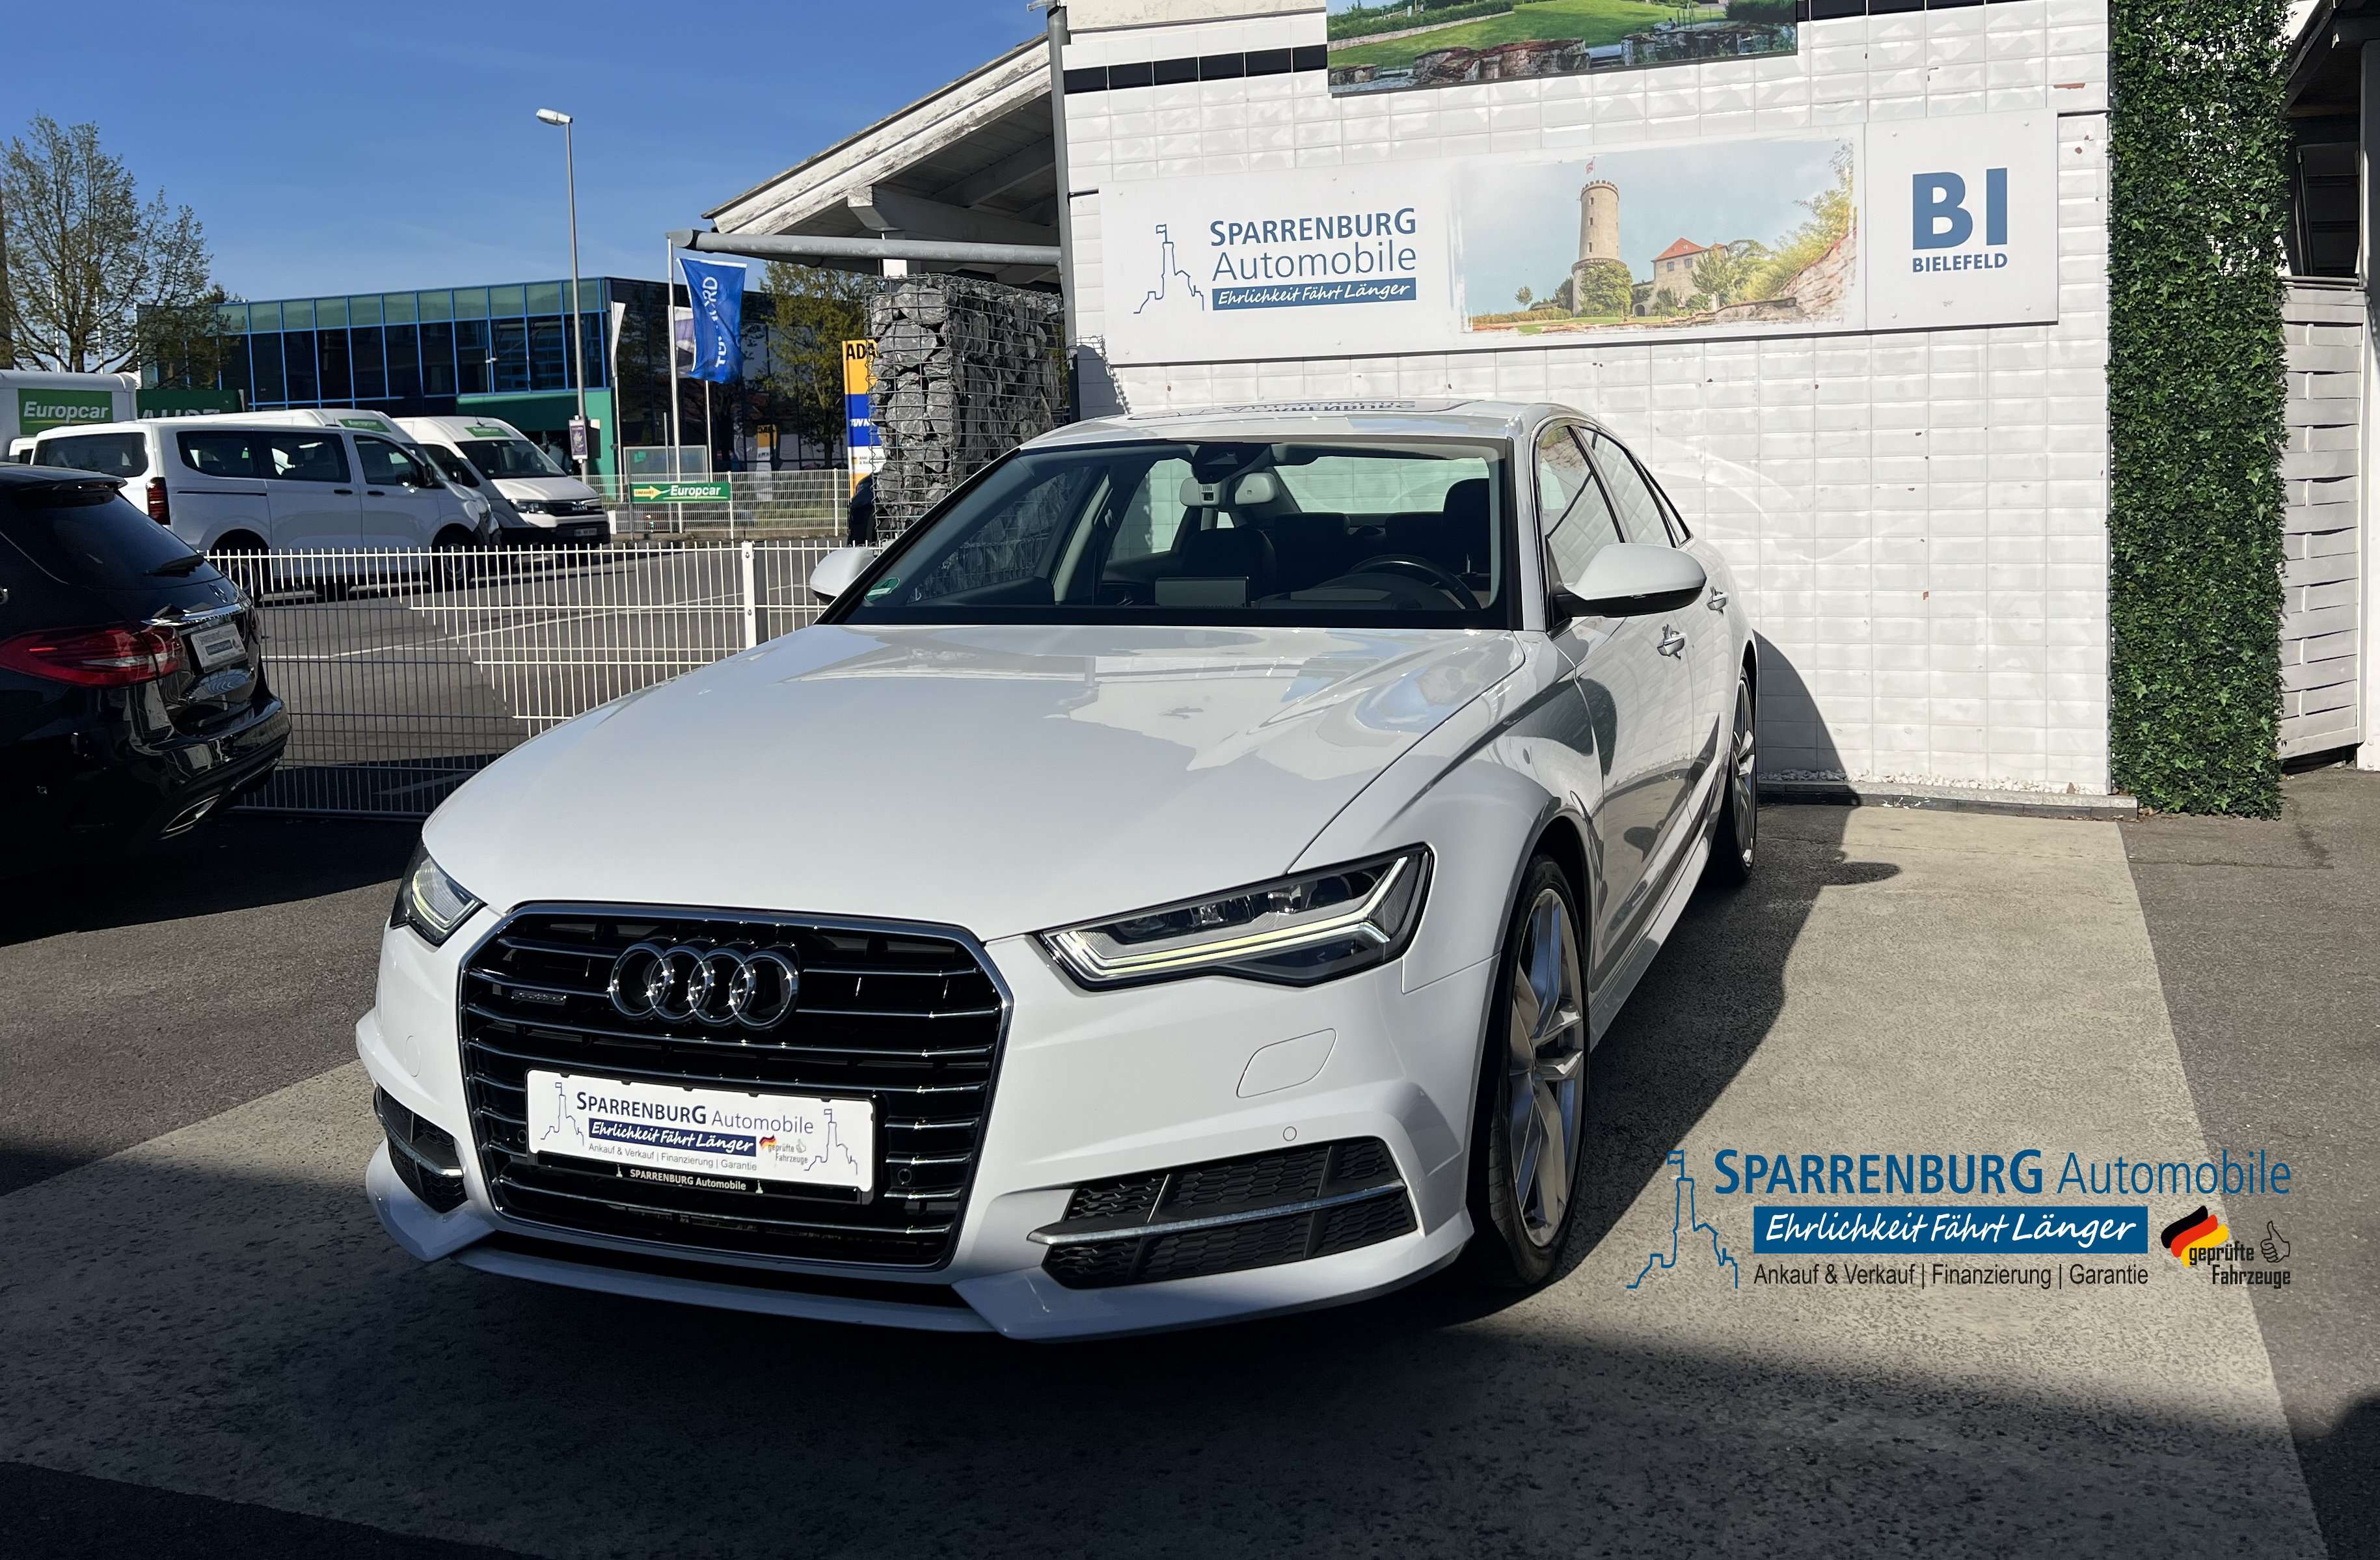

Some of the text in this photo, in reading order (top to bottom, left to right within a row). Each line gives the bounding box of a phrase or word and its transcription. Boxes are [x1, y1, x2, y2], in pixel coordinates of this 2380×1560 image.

[1912, 167, 2008, 251] BI
[1210, 207, 1416, 247] SPARRENBURG
[1211, 239, 1416, 282] Automobile
[1912, 253, 2008, 273] BIELEFELD
[1217, 283, 1411, 305] Ehrlichkeit Fährt Länger
[23, 400, 109, 423] Europcar
[669, 484, 722, 499] Europcar
[576, 1091, 814, 1134] SPARRENBURG Automobile
[591, 1121, 755, 1154] Ehrlichkeit Fährt Länger
[768, 1142, 795, 1153] geprüfte
[588, 1143, 615, 1155] Ankauf
[617, 1147, 623, 1155] &
[625, 1147, 655, 1160] Verkauf
[660, 1153, 714, 1168] Finanzierung
[721, 1159, 757, 1171] Garantie
[775, 1153, 809, 1166] Fahrzeuge
[629, 1169, 747, 1190] SPARRENBURG Automobile
